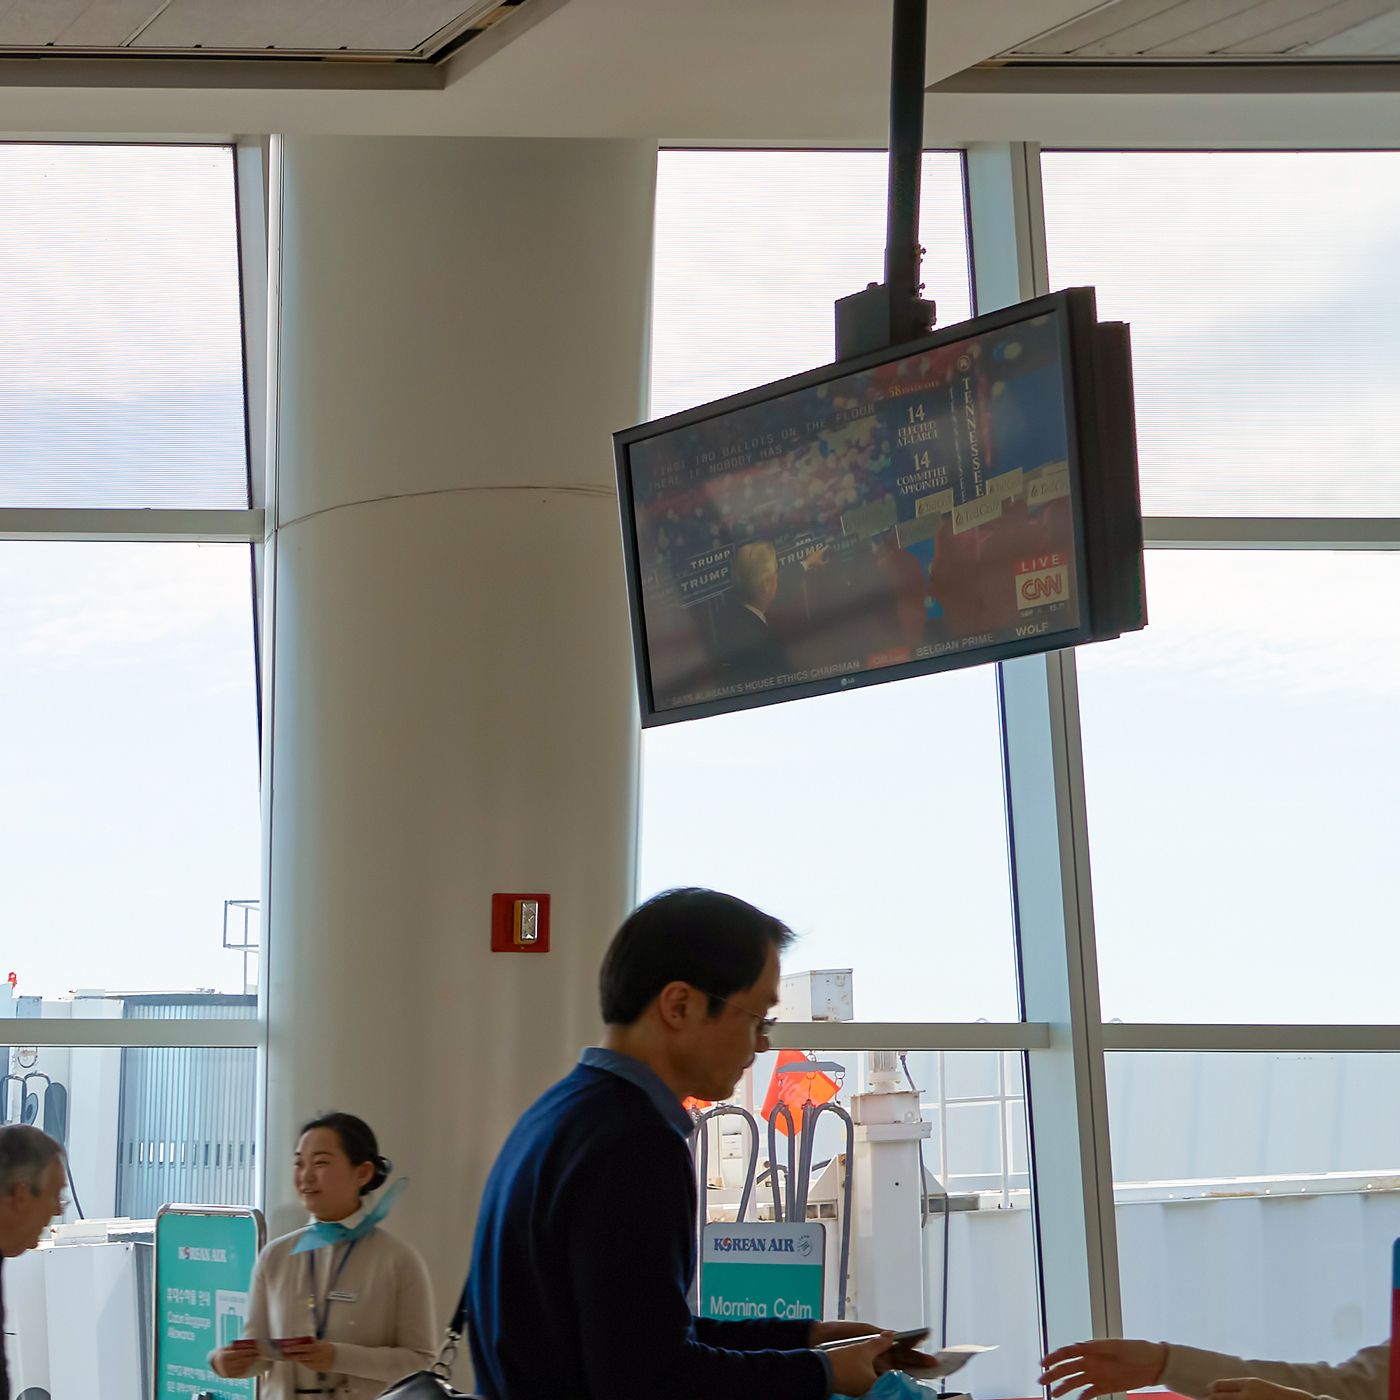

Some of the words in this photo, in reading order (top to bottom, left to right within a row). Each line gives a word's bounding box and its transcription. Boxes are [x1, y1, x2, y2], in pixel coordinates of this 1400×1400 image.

[908, 404, 926, 424] 14
[898, 421, 937, 438] ELECTED
[962, 376, 985, 497] TENNESSEE
[913, 450, 931, 471] 14
[896, 467, 947, 486] COMMITTEE
[900, 475, 948, 495] APPOINTED
[689, 549, 732, 569] TRUMP
[778, 542, 824, 567] TRUMP
[1022, 553, 1060, 572] LIVE
[680, 567, 729, 592] TRUMP
[1021, 572, 1062, 601] CNN
[1015, 622, 1048, 636] WOLF
[916, 640, 960, 657] BELGIAN
[961, 633, 995, 647] PRIME
[744, 676, 775, 691] HOUSE
[776, 671, 809, 686] ETHICS
[810, 660, 860, 678] CHAIRMAN
[713, 1236, 766, 1253] KOREAN
[767, 1238, 795, 1253] AIR
[709, 1295, 767, 1318] Morning
[773, 1298, 813, 1320] Calm
